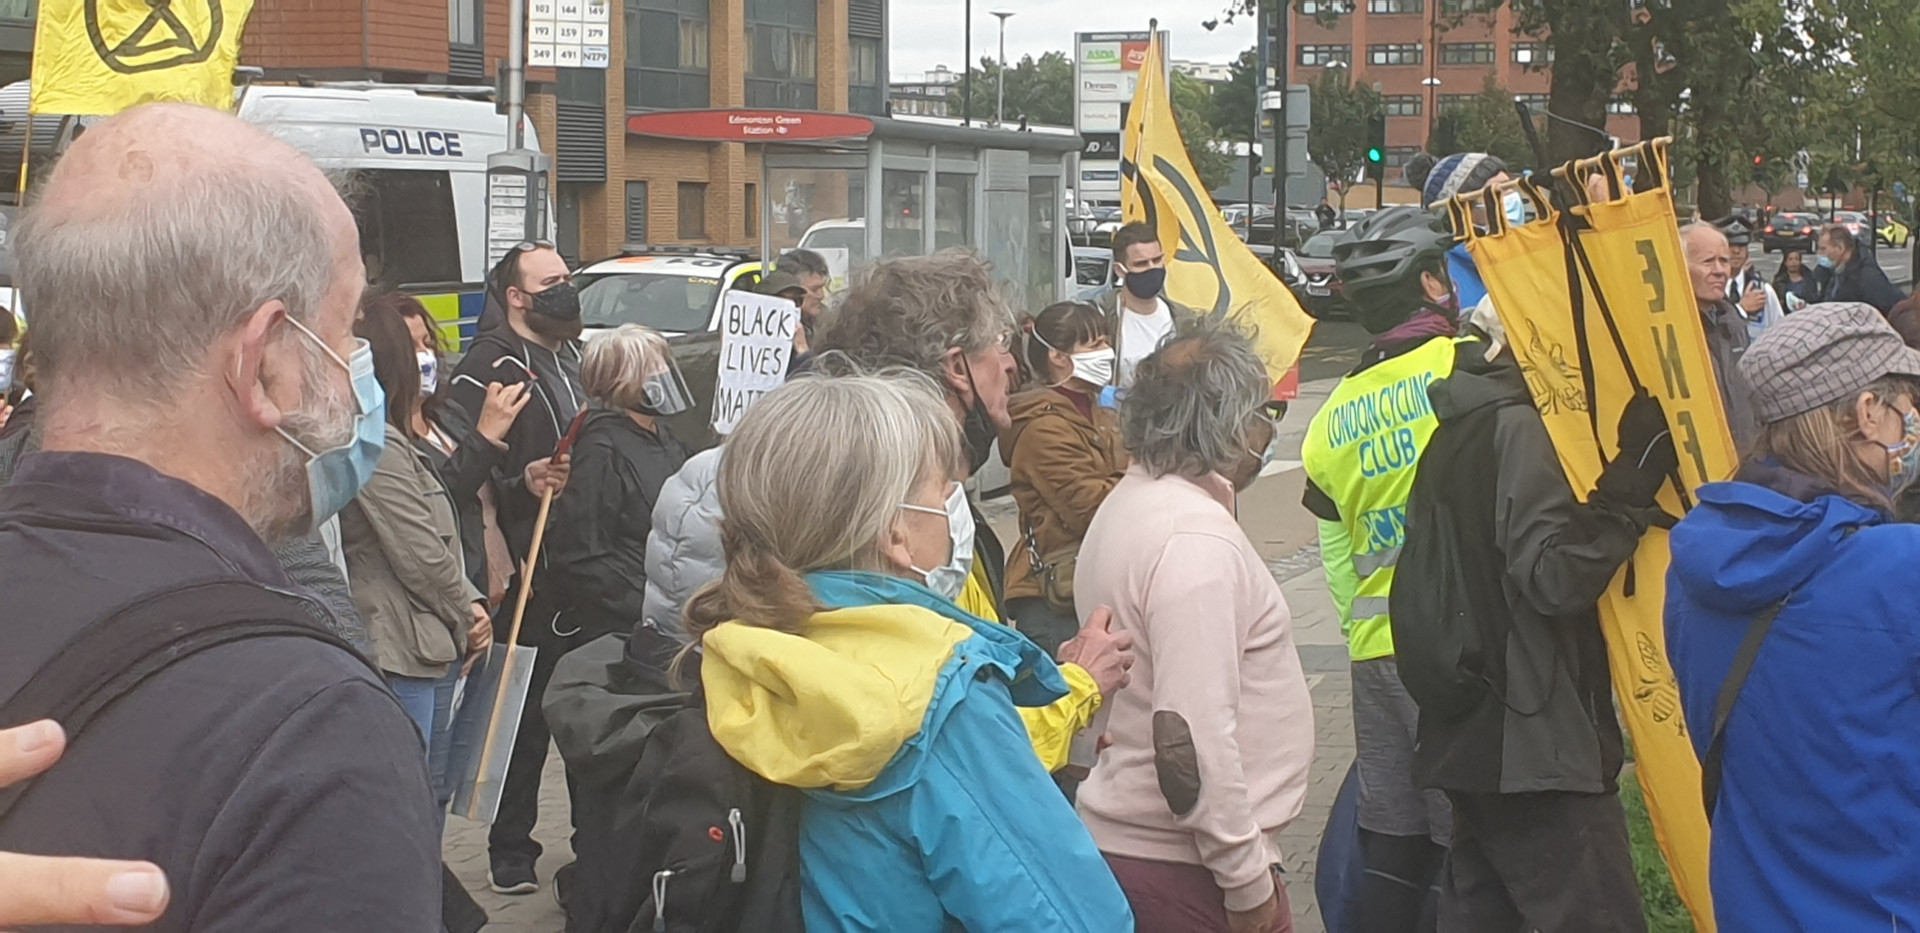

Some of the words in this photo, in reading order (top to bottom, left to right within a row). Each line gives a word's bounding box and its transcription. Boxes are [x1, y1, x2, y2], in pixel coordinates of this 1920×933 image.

[588, 7, 605, 16] 149
[560, 27, 578, 38] 259
[587, 28, 604, 38] 279
[533, 49, 551, 59] 349
[560, 50, 577, 60] 491
[583, 52, 608, 62] N279
[1086, 49, 1116, 60] ASDA
[728, 114, 774, 125] Edmonton
[774, 115, 802, 125] Green
[742, 125, 774, 135] Station
[359, 128, 463, 157] POLICE
[1085, 141, 1101, 153] JD
[729, 304, 792, 338] BLACK
[726, 342, 782, 376] LIVES
[1326, 391, 1382, 449] LONDON
[1358, 427, 1417, 478] CLUB
